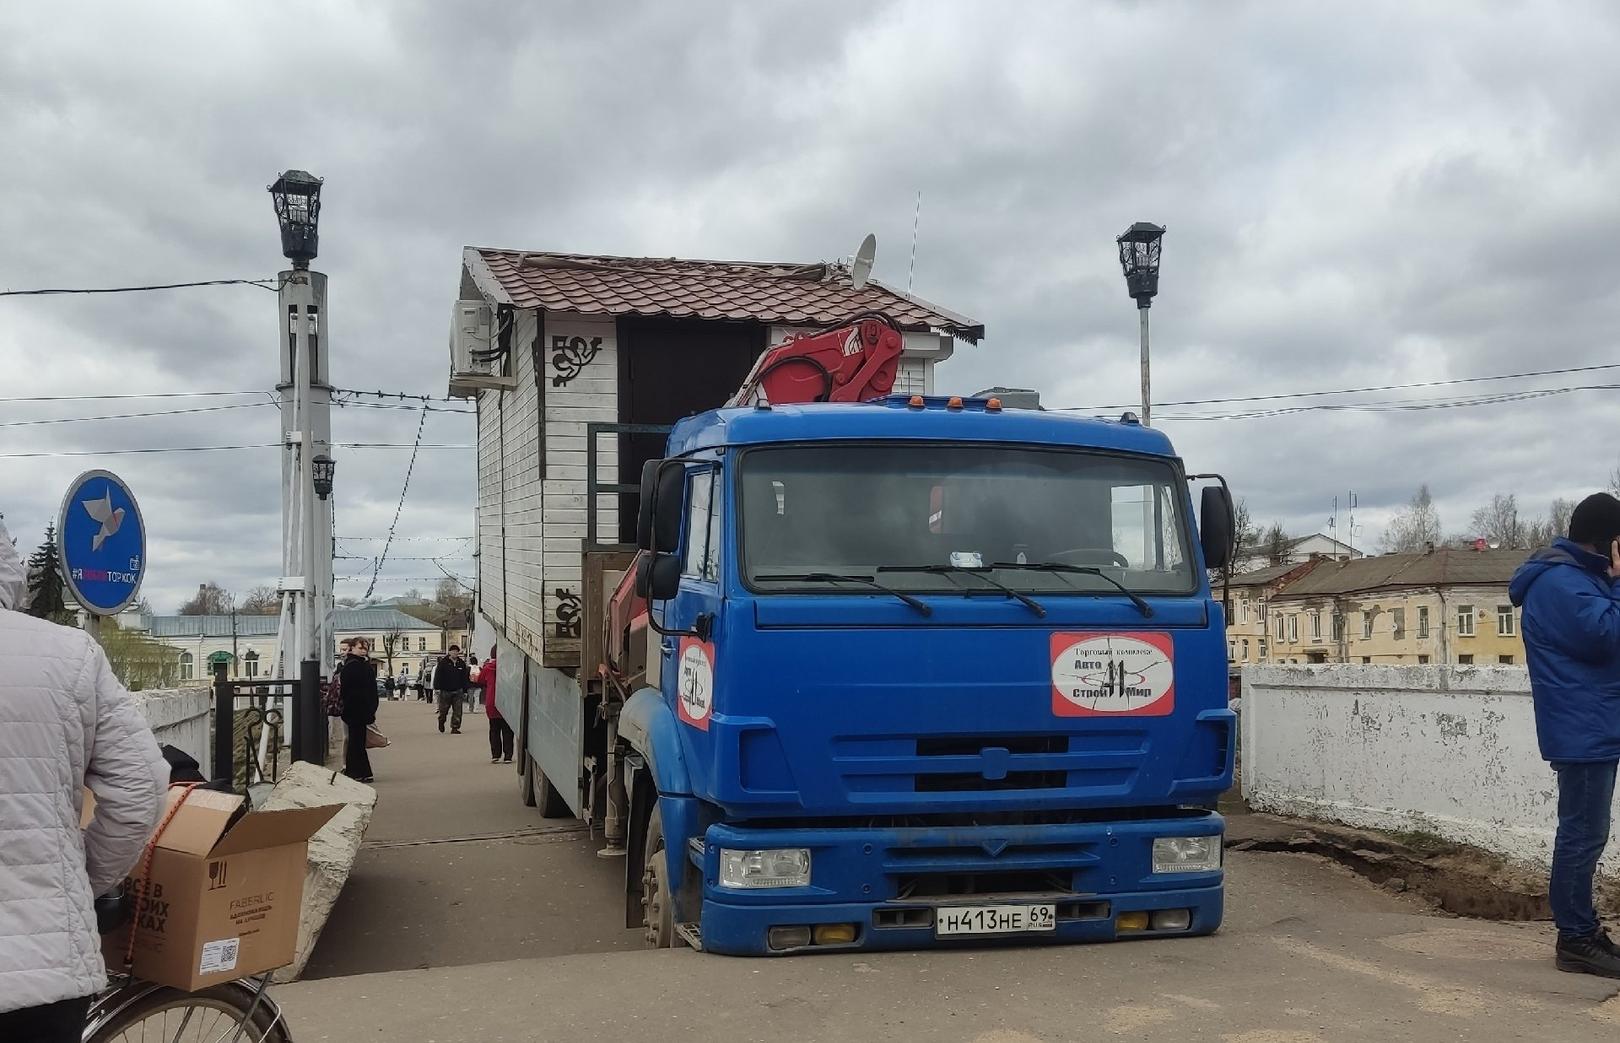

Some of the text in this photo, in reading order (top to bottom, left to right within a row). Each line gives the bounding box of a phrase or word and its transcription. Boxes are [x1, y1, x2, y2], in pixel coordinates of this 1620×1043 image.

[1074, 659, 1102, 669] Авто
[1072, 687, 1152, 698] Строй Мир
[1030, 907, 1049, 922] 69
